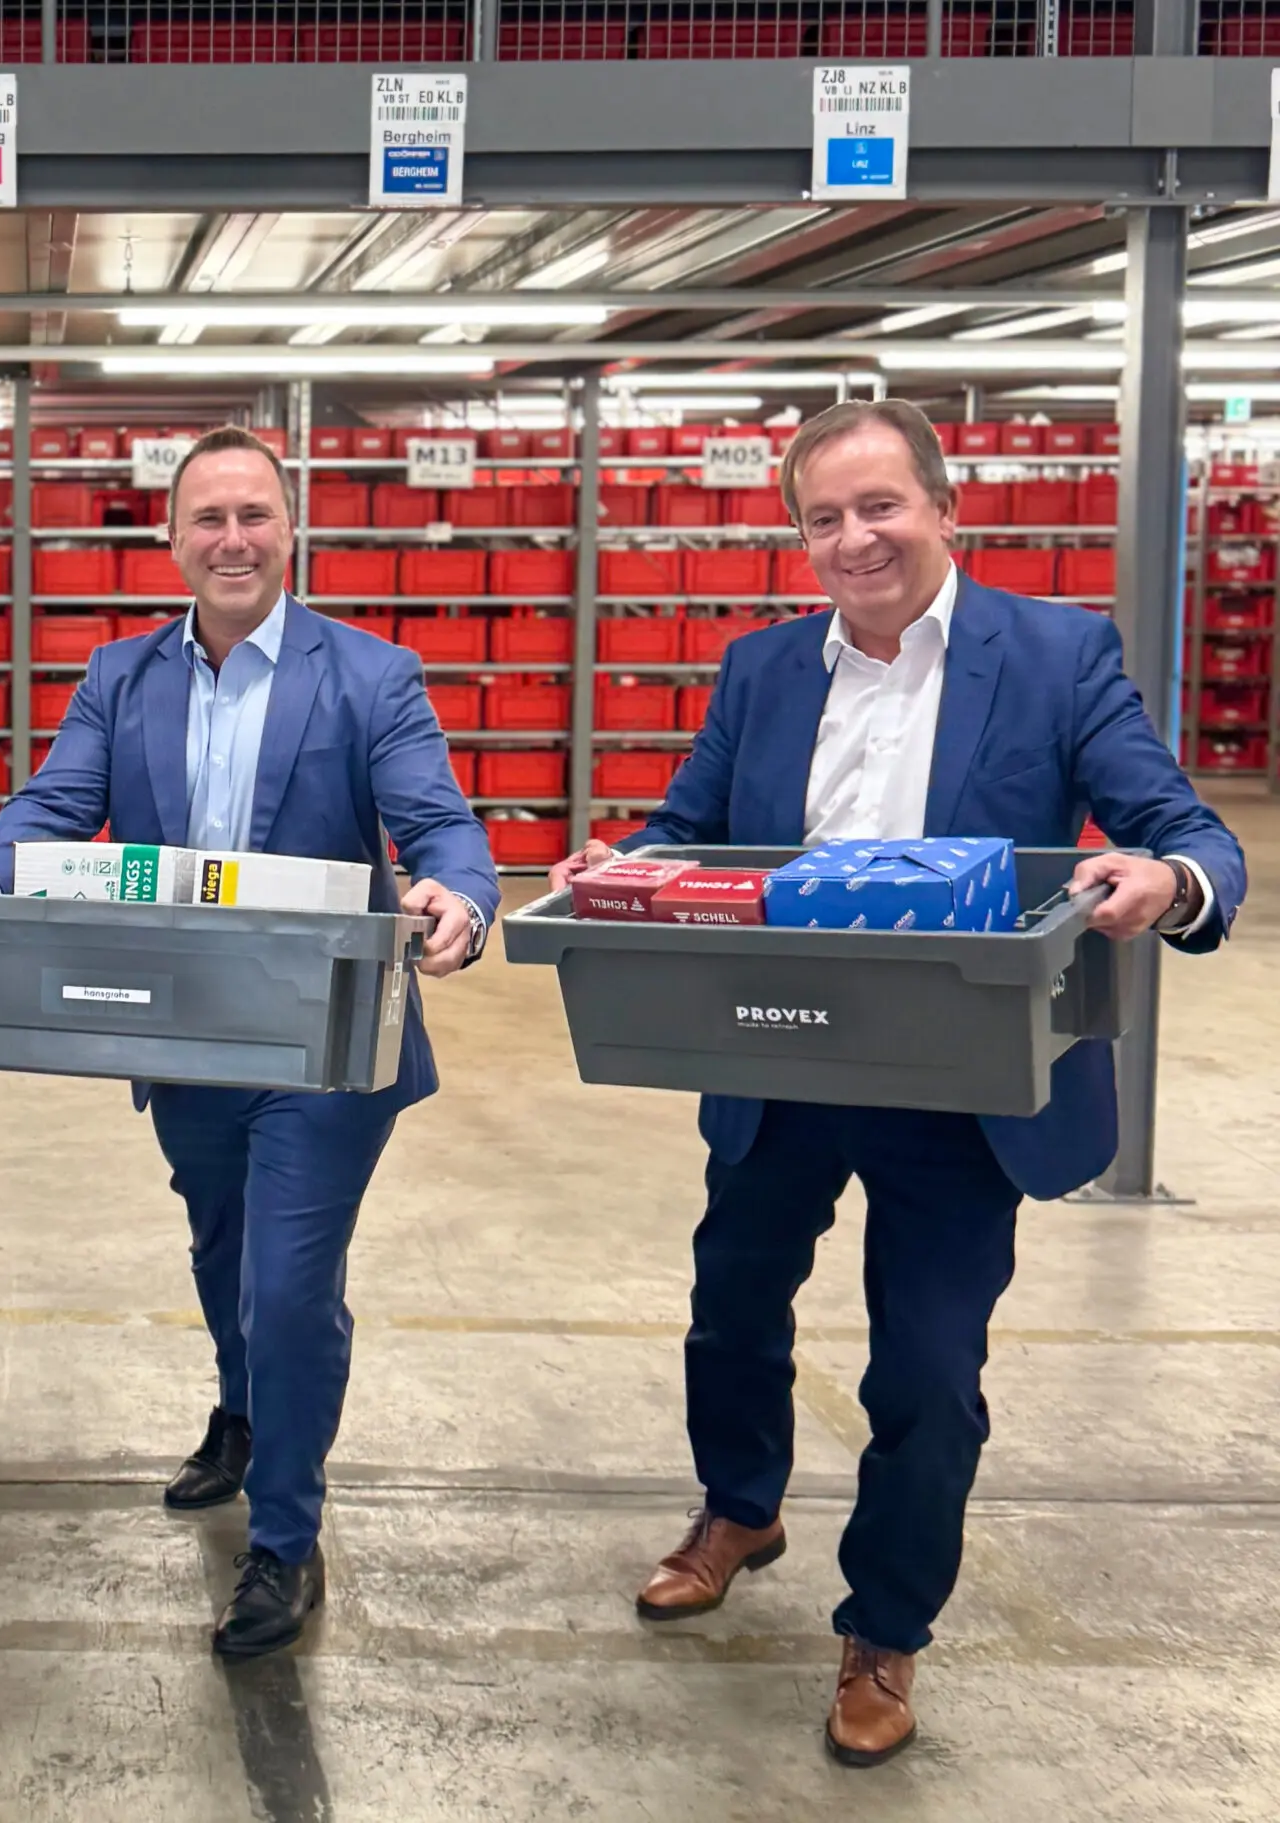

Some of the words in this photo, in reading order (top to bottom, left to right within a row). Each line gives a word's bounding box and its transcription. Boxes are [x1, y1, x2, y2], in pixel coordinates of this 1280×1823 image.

[821, 70, 846, 84] ZJ8
[376, 77, 404, 92] ZLN
[859, 81, 876, 94] NZ
[879, 81, 896, 94] KL
[6, 93, 15, 106] B
[437, 90, 453, 104] KL
[846, 122, 877, 136] Linz
[382, 130, 452, 145] Bergheim
[392, 166, 439, 177] BERGHEIM
[416, 446, 468, 467] M13
[710, 446, 763, 467] M05
[124, 859, 142, 901] INGS
[202, 863, 220, 901] viega
[589, 897, 628, 911] SCHELL
[693, 912, 740, 923] SCHELL
[735, 1005, 830, 1026] PROVEX
